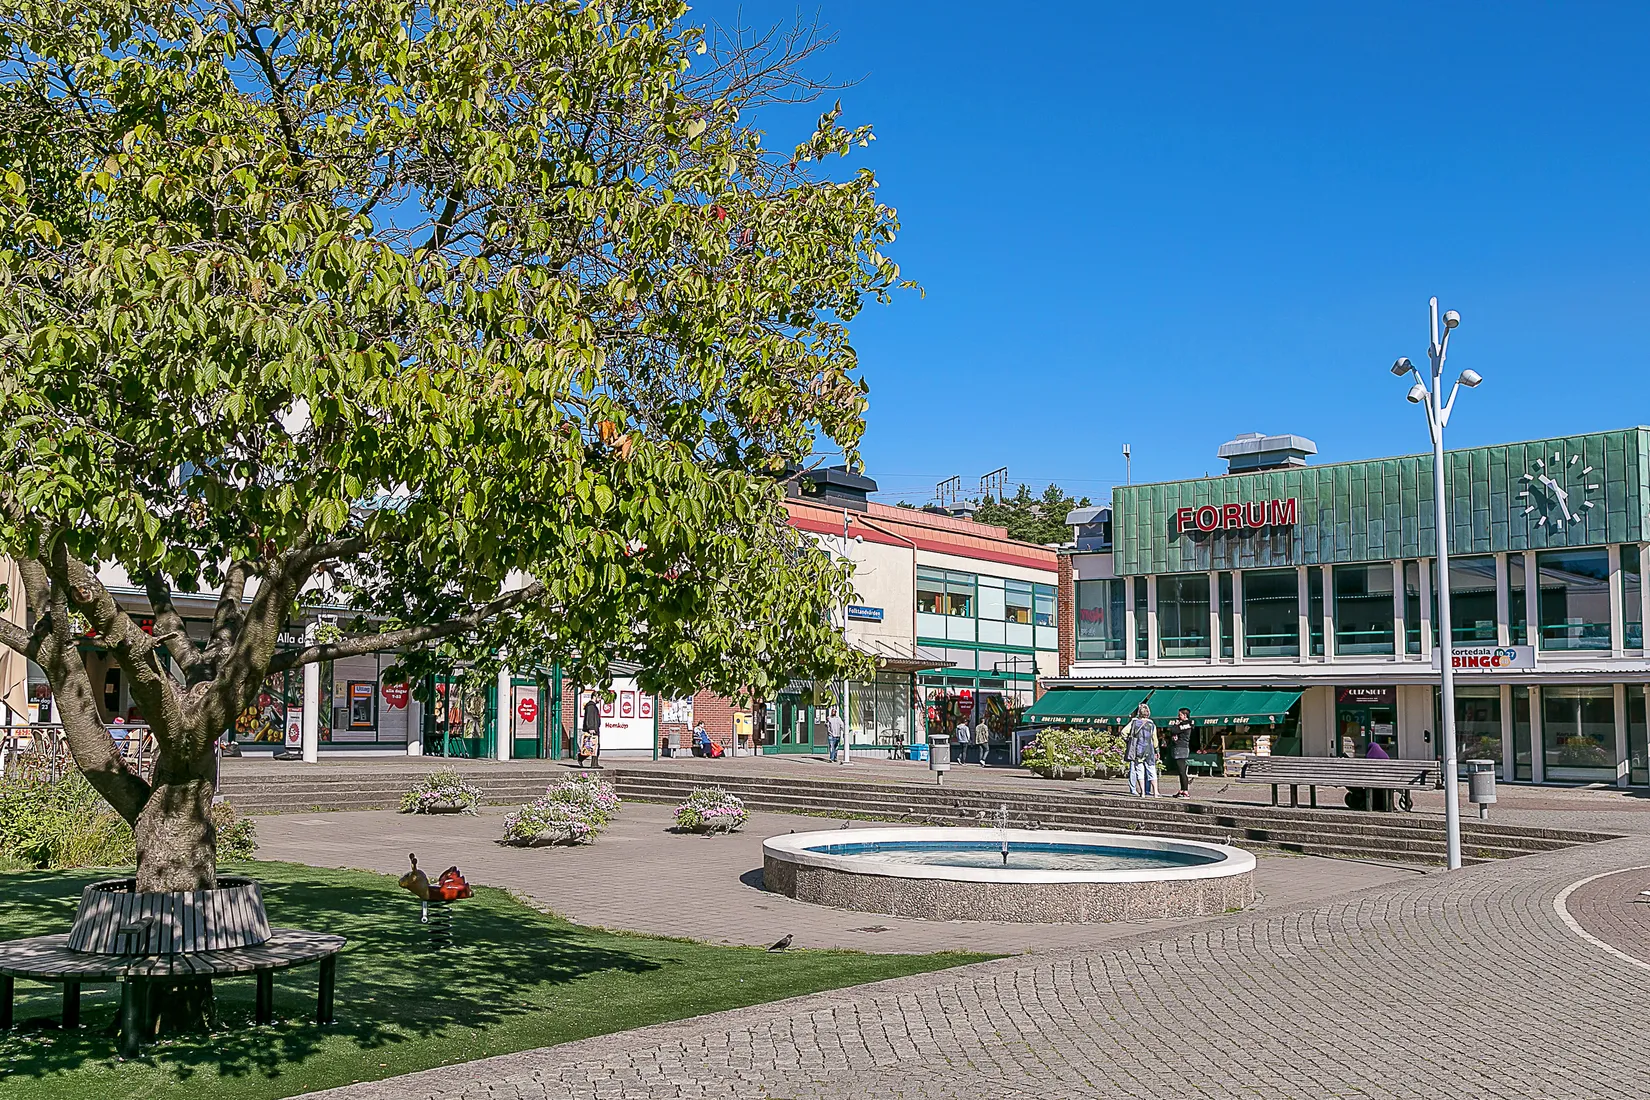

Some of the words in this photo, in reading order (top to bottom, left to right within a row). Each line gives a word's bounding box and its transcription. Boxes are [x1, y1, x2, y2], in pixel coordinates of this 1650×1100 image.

[1176, 497, 1298, 533] FORUM
[277, 632, 295, 643] Alla
[1452, 656, 1501, 668] BINGO
